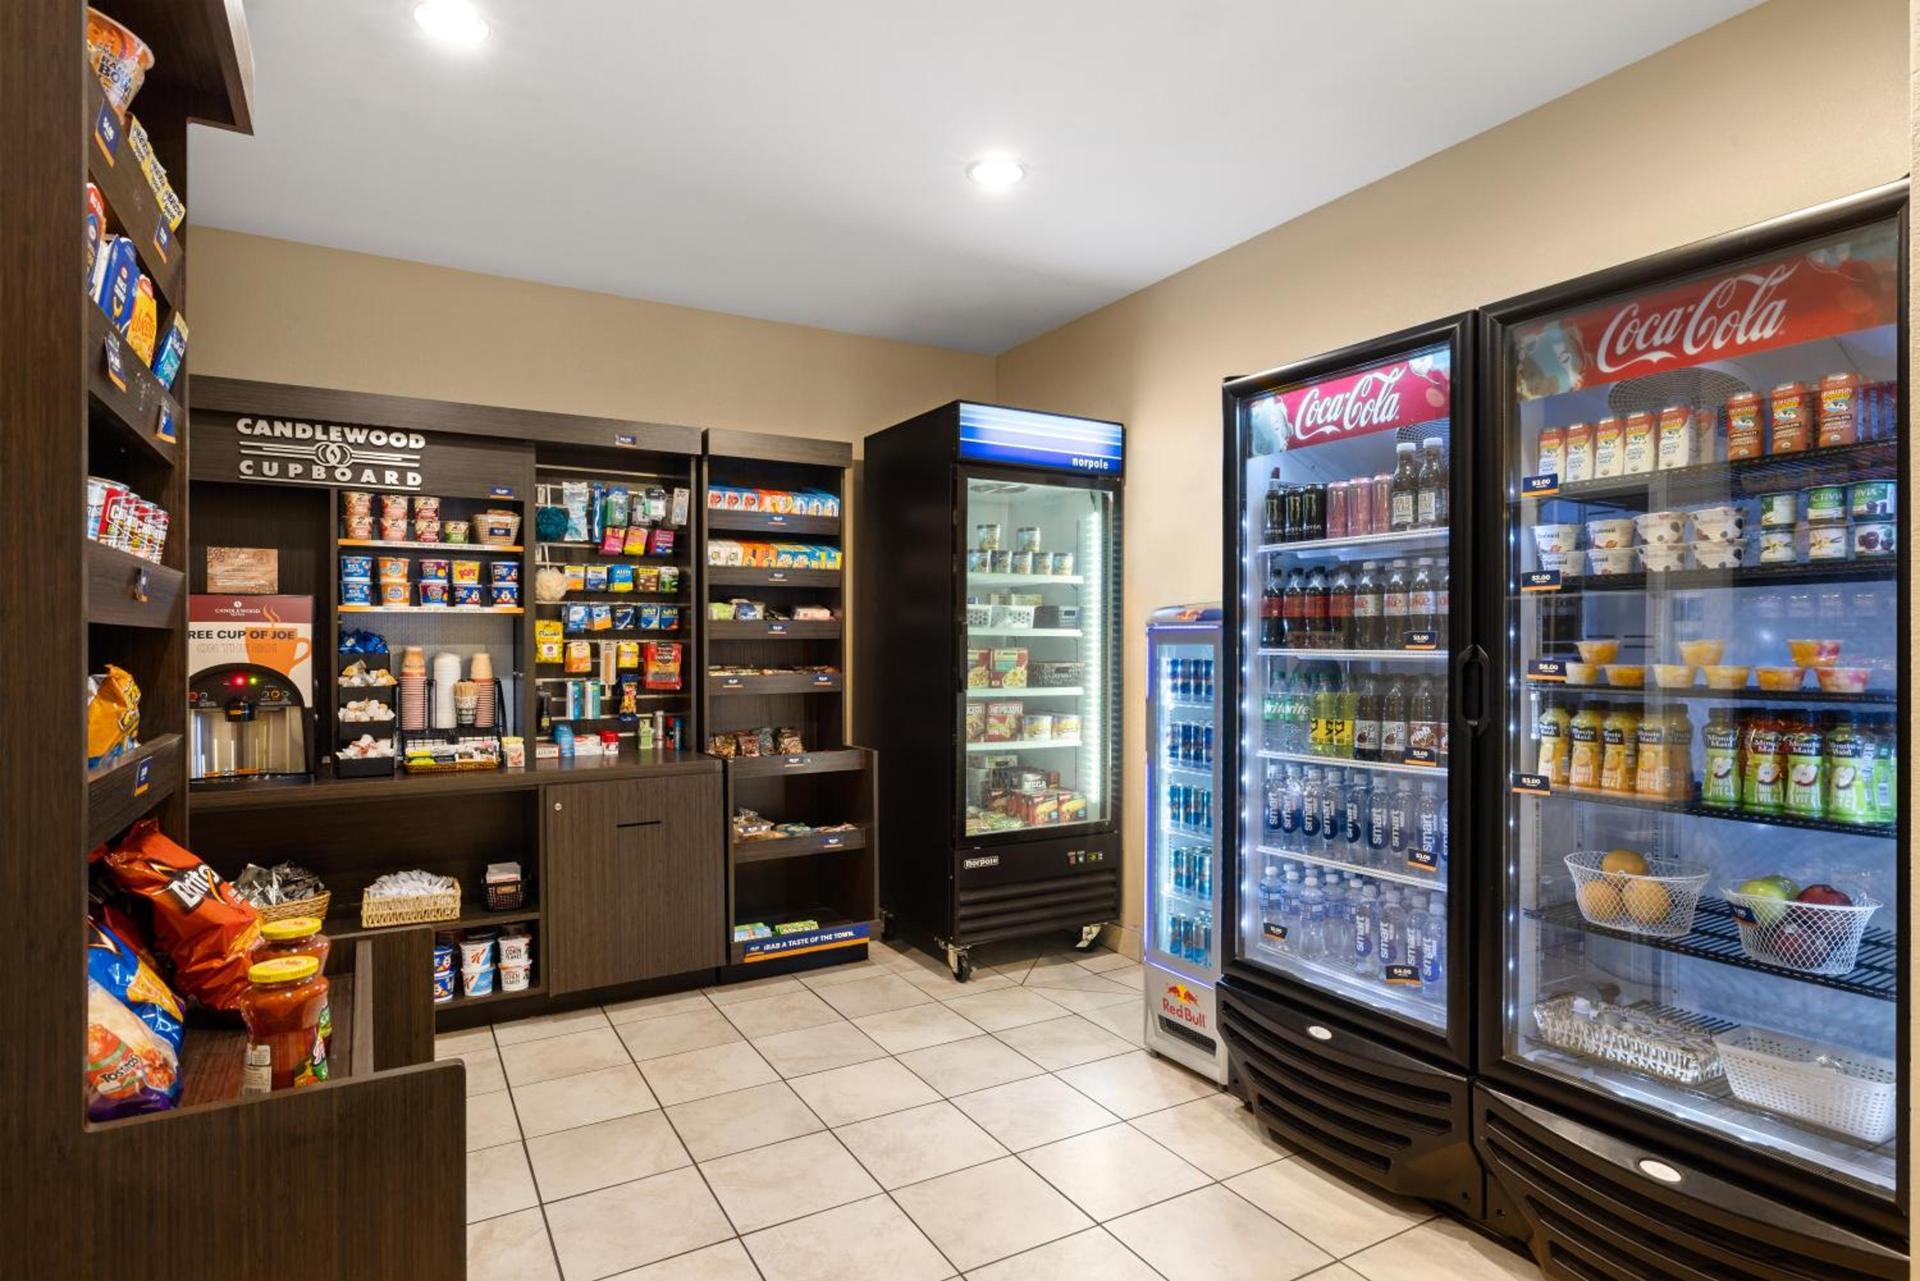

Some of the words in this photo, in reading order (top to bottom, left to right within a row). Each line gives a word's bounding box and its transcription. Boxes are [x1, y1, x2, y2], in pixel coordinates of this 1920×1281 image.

[1597, 261, 1800, 374] Coca-Cola
[1295, 366, 1407, 441] Coca-Cola
[236, 417, 426, 449] CANDLEWOOD
[239, 460, 423, 487] CUPBOARD
[1072, 457, 1109, 470] norpole
[189, 630, 214, 640] REE
[217, 630, 246, 640] CUP
[250, 630, 268, 640] OF
[271, 630, 296, 640] JOE
[1371, 808, 1382, 845] smart
[1392, 810, 1400, 848] smart
[788, 938, 808, 947] TASTE
[1162, 998, 1183, 1018] Red
[1184, 1008, 1206, 1028] Bull
